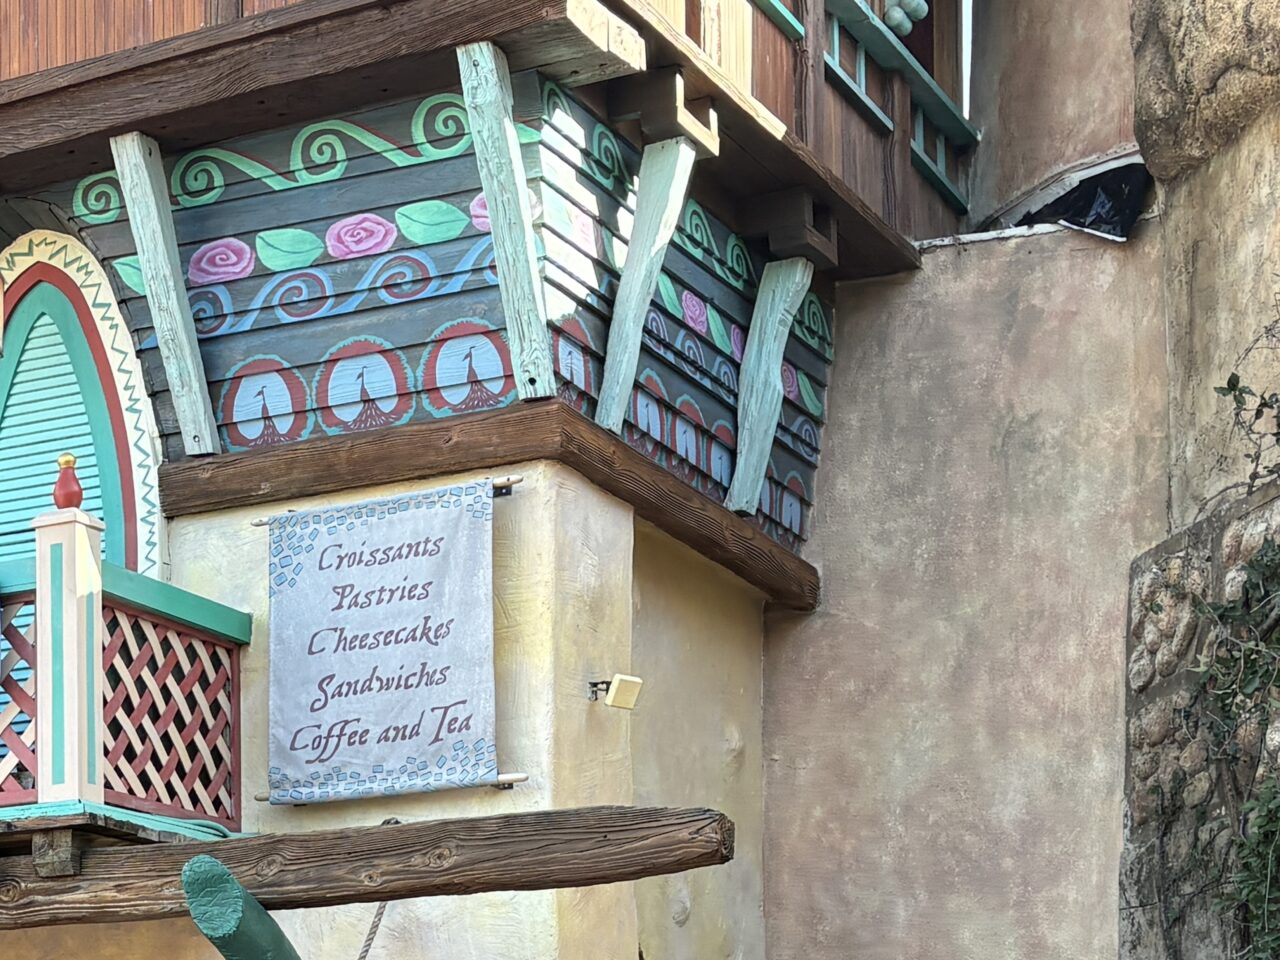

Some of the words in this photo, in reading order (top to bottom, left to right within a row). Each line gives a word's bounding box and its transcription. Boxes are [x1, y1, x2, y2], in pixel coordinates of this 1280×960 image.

[318, 535, 445, 571] Croissants
[331, 576, 434, 611] Pastries
[307, 616, 455, 655] Cheesecakes
[309, 662, 451, 712] Sandwiches
[289, 717, 369, 765] Coffee
[376, 711, 425, 744] and
[428, 700, 475, 745] Tea
